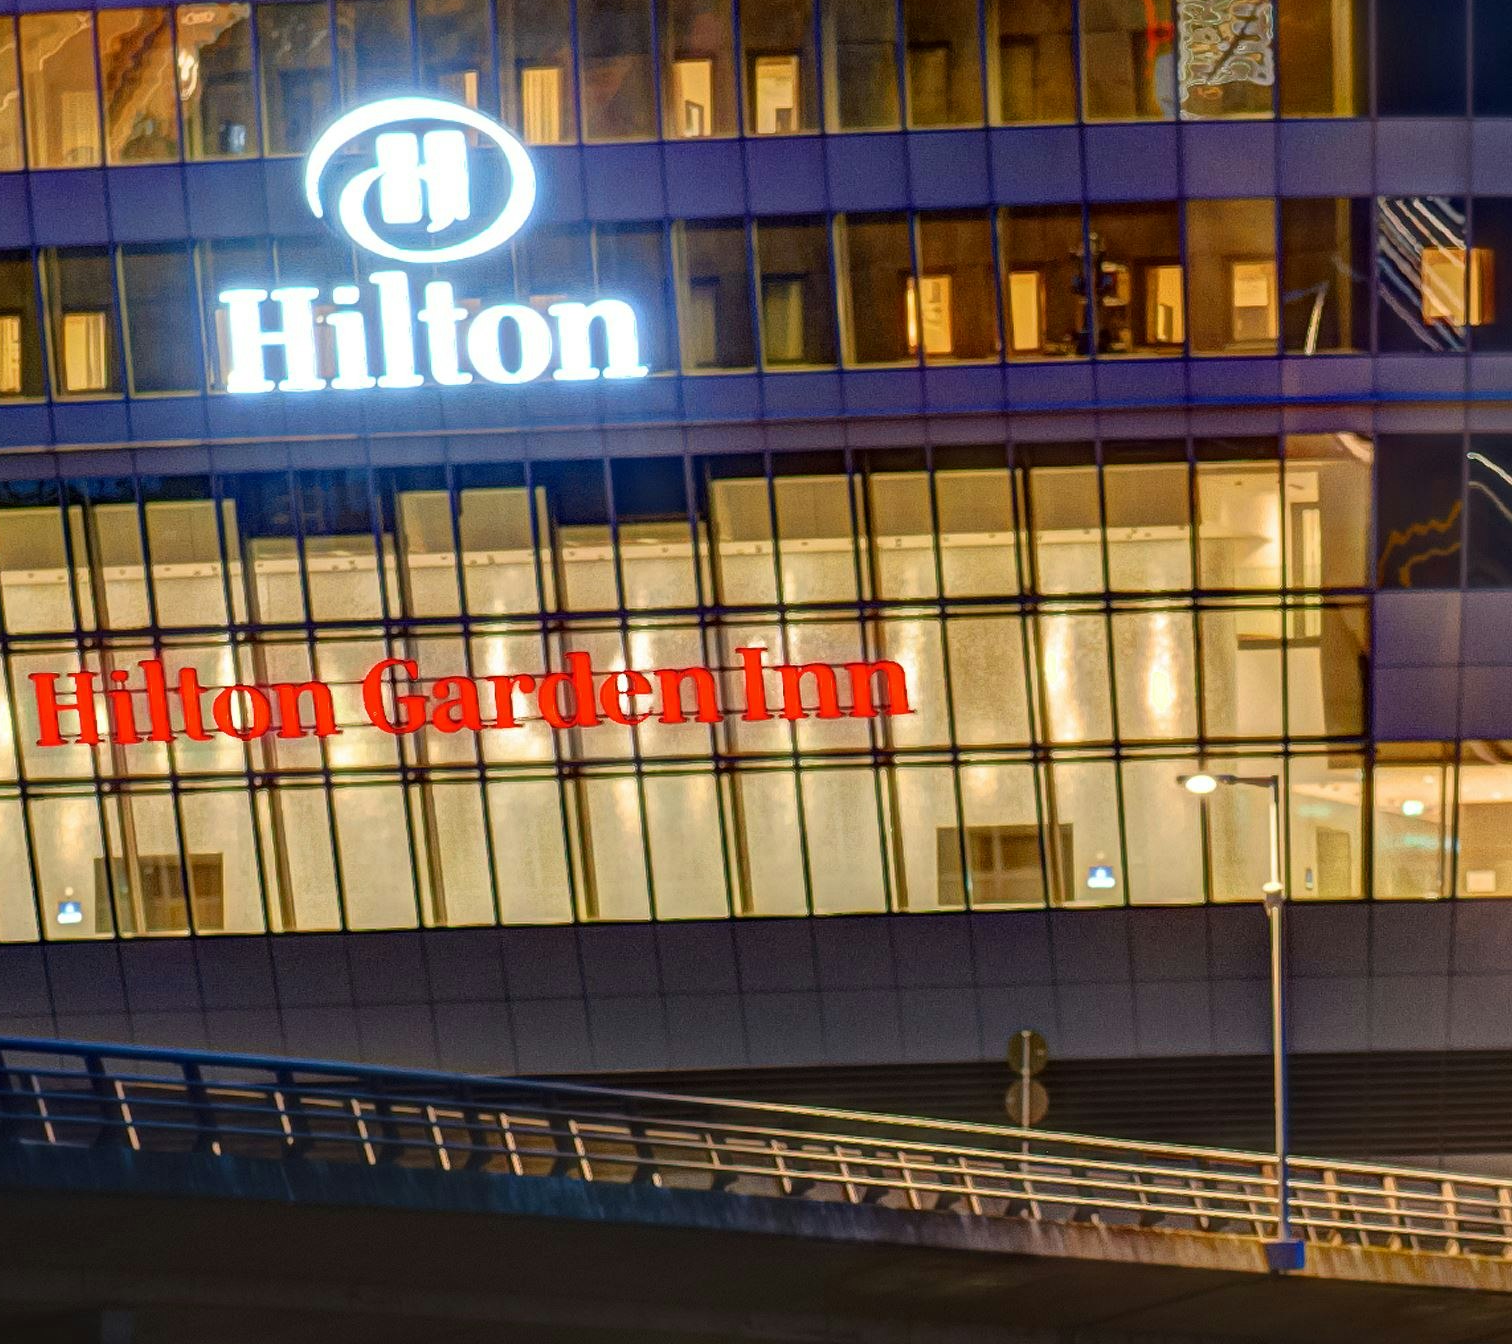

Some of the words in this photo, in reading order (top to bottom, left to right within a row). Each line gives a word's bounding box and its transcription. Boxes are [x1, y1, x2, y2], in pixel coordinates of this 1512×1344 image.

[219, 270, 649, 393] Hilton
[28, 659, 343, 747] Hilton
[362, 651, 724, 734] Garden
[735, 647, 916, 721] Inn
